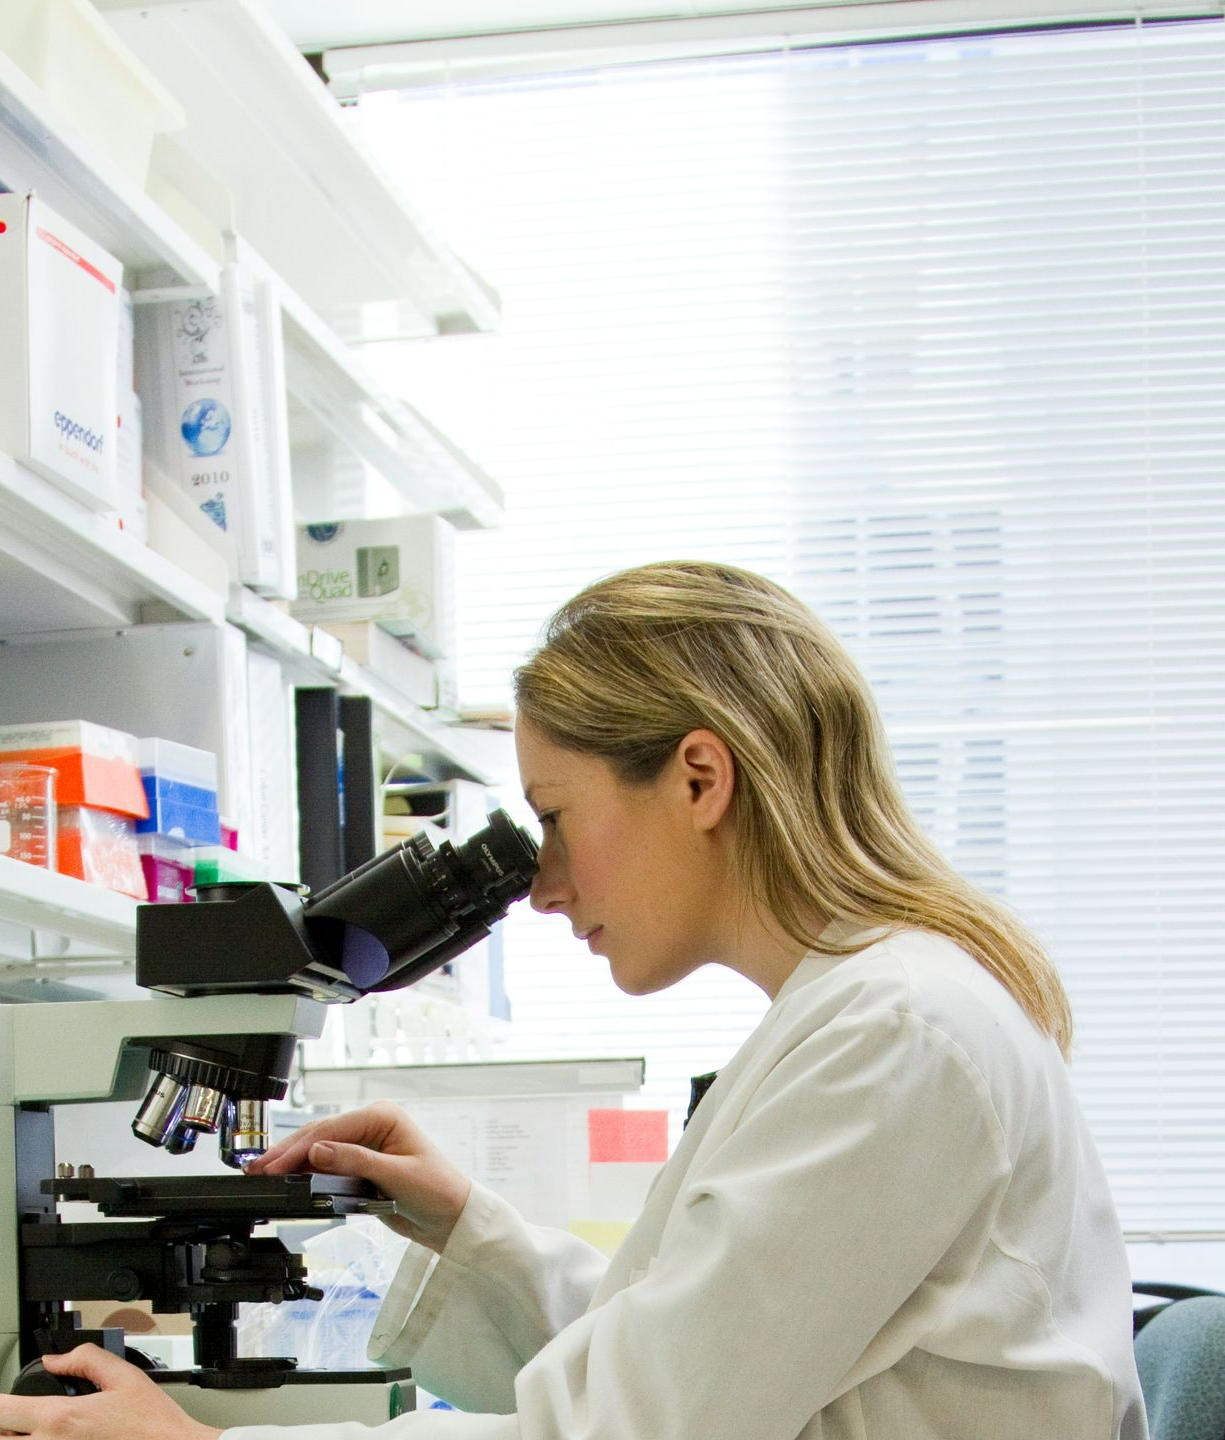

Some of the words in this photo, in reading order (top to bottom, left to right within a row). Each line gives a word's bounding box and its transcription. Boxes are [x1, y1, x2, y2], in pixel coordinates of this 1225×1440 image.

[54, 410, 104, 456] eppendorf
[192, 471, 229, 486] 2010
[310, 580, 351, 604] Quad
[21, 812, 32, 821] 50
[19, 832, 32, 841] 100
[481, 843, 504, 877] OLYMPUS
